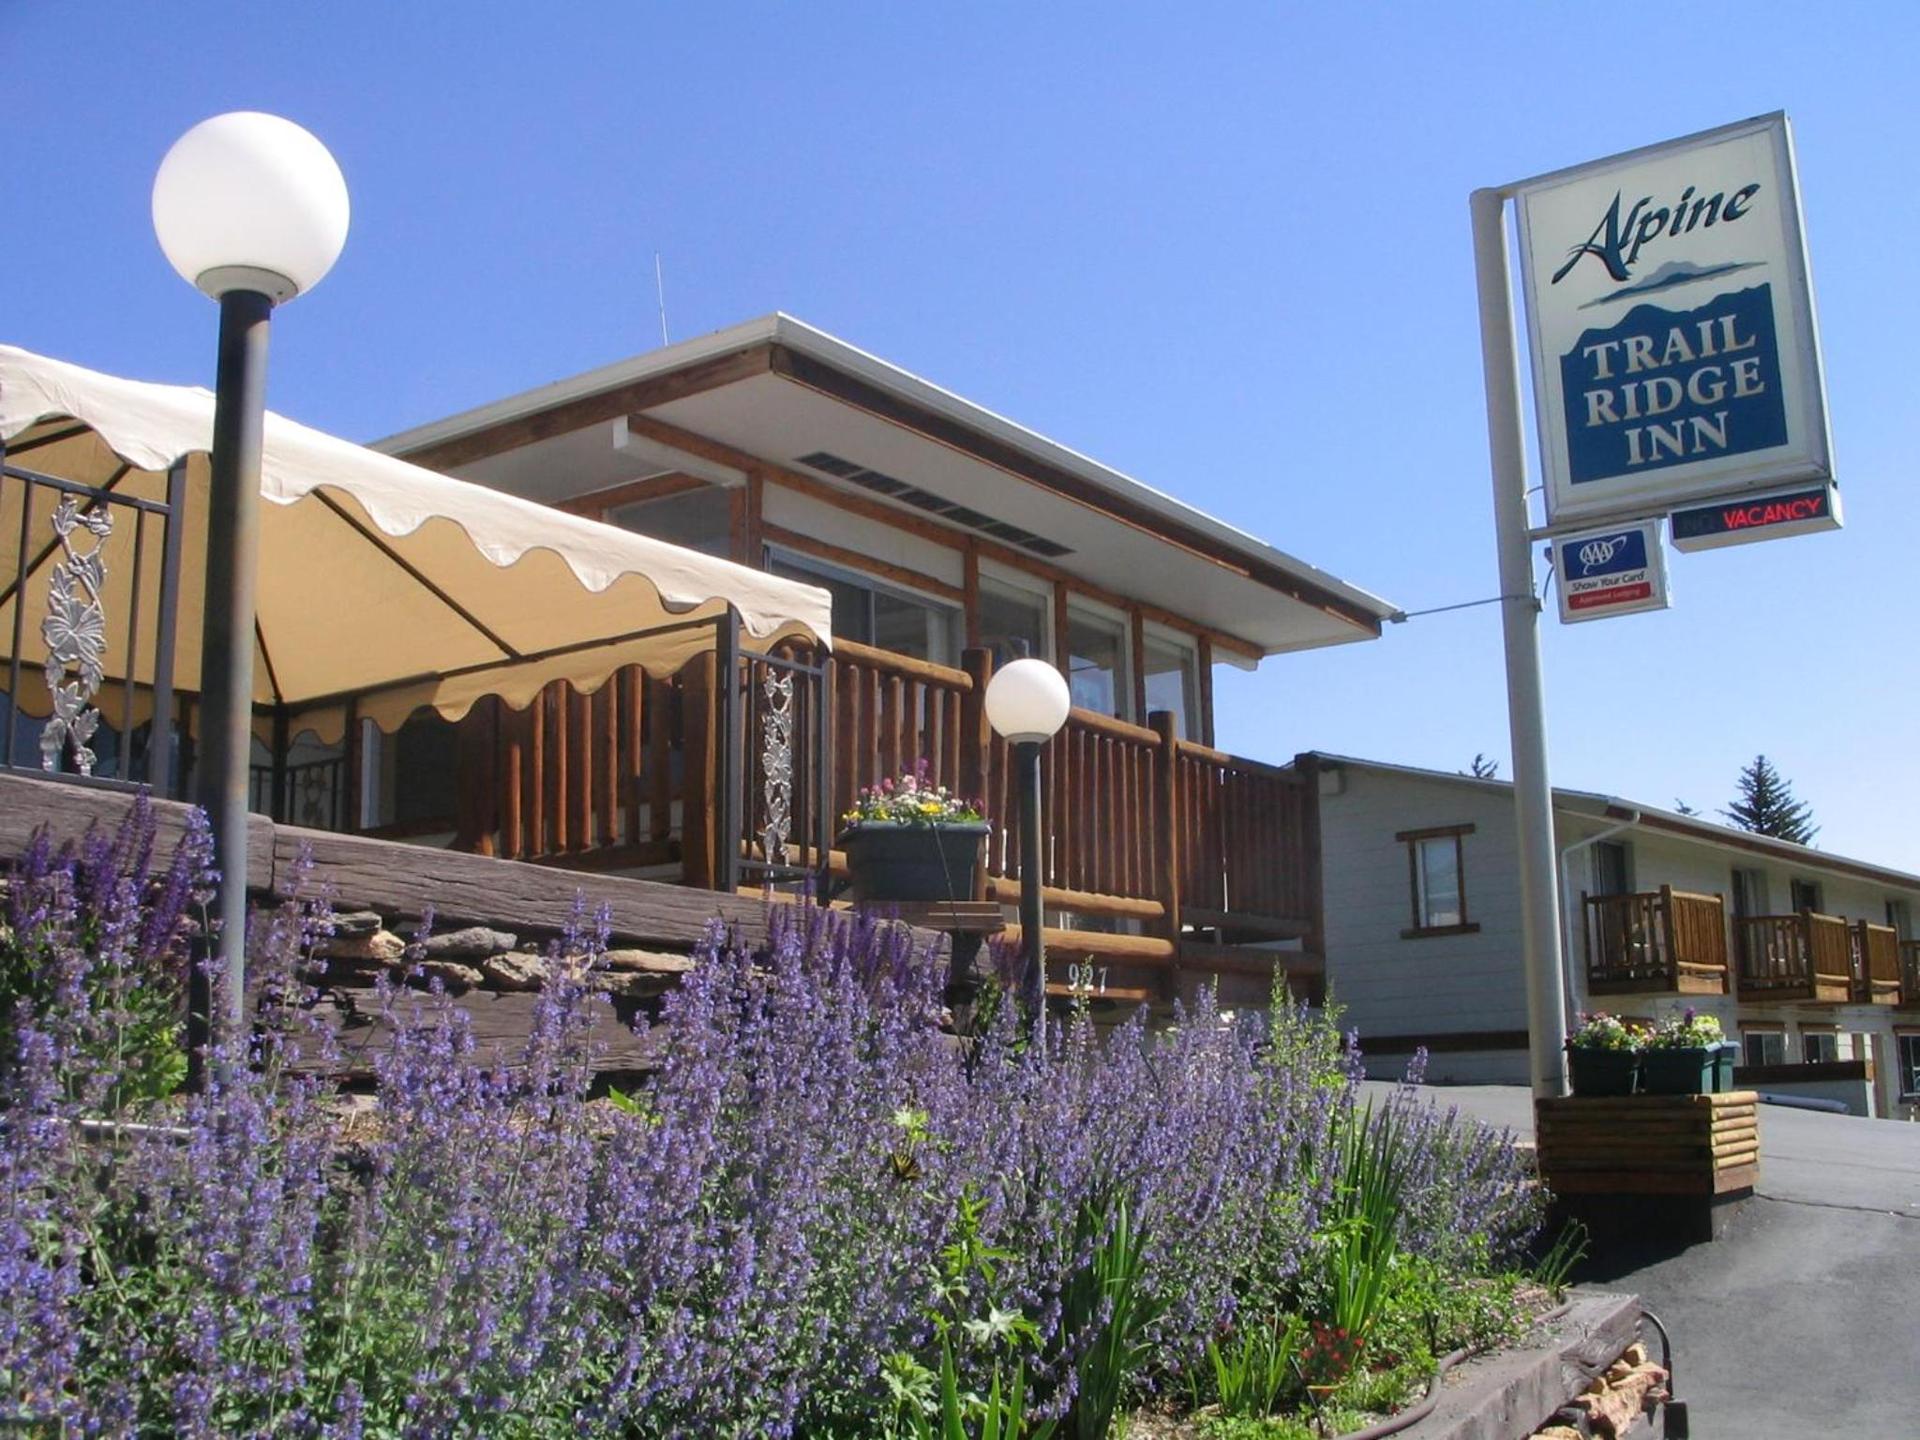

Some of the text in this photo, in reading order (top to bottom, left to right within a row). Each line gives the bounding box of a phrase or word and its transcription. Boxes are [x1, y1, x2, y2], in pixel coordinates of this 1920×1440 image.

[1551, 183, 1761, 284] Alpine
[1583, 314, 1755, 380] TRAIL
[1584, 356, 1765, 427] RIDGE
[1625, 411, 1730, 466] INN
[1723, 497, 1821, 528] VACANCY
[1582, 542, 1612, 563] AAA
[1572, 571, 1645, 592] Show Your Card
